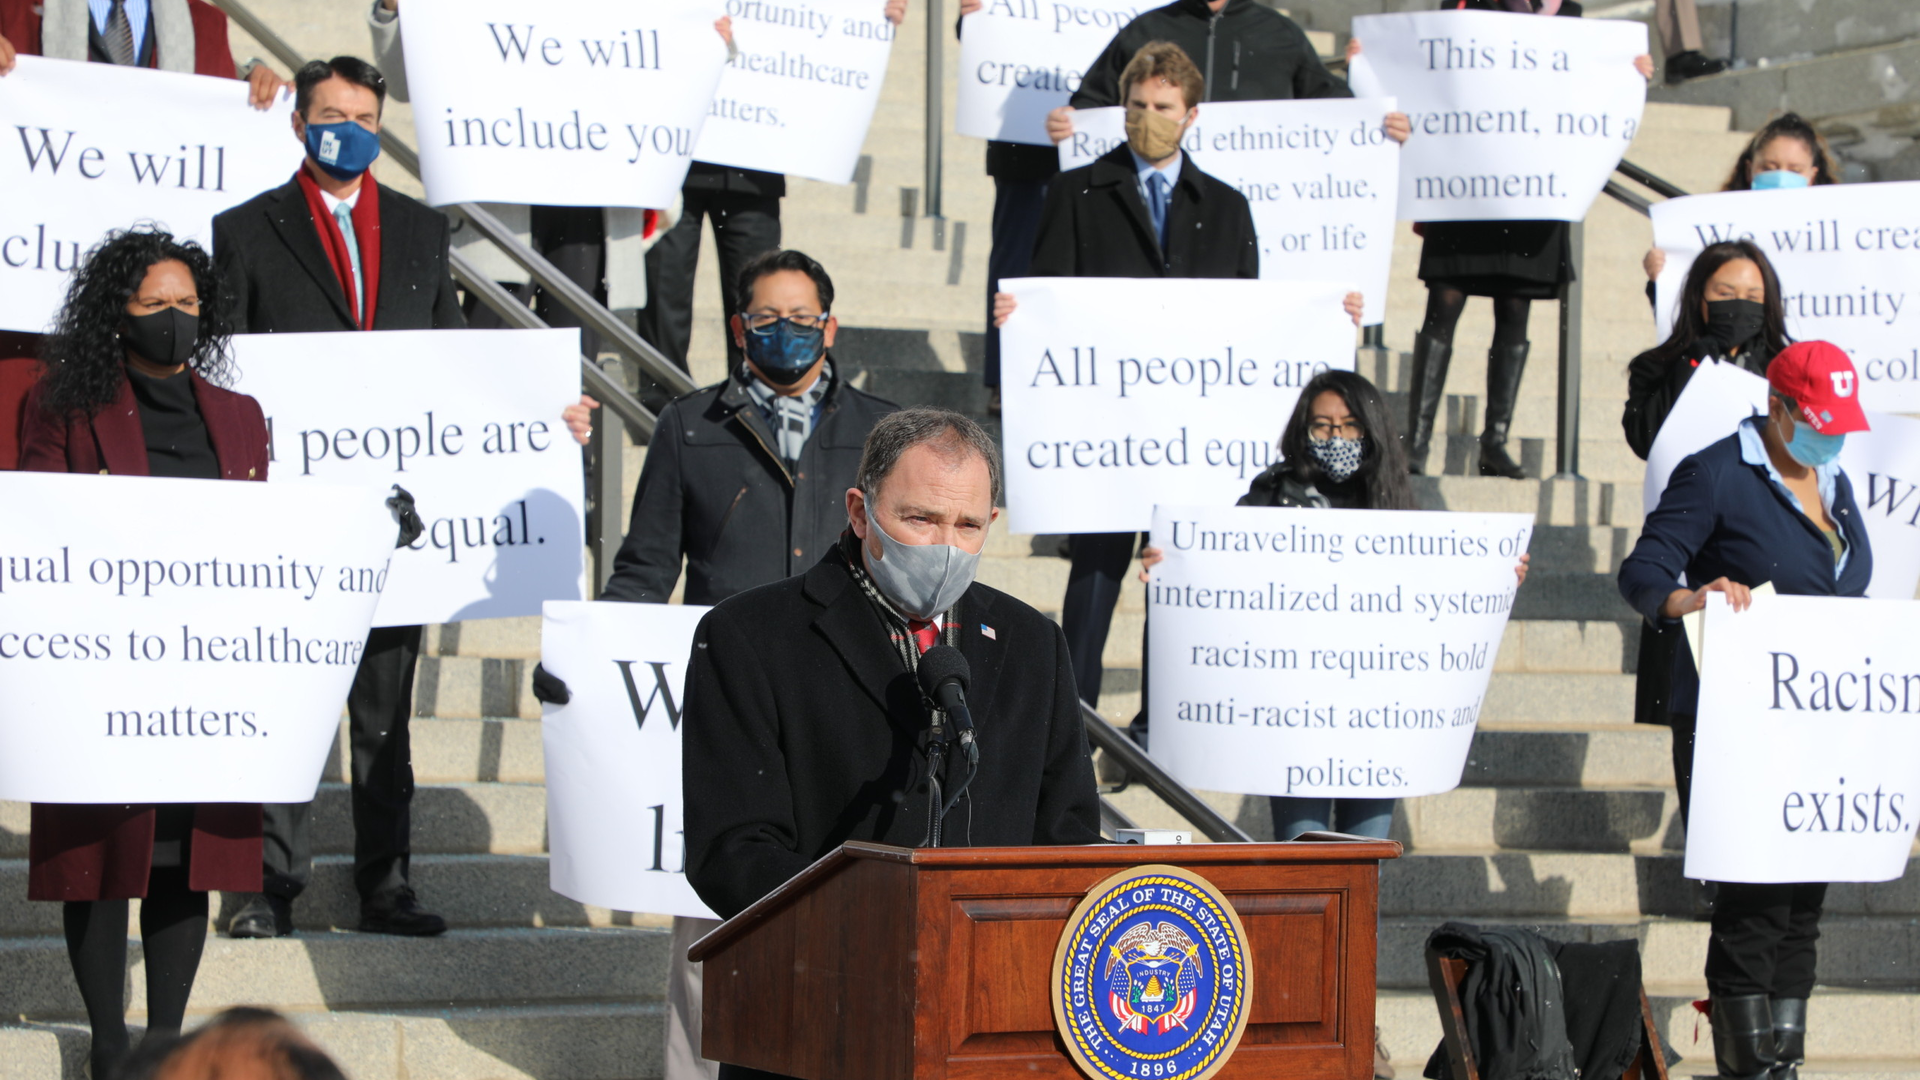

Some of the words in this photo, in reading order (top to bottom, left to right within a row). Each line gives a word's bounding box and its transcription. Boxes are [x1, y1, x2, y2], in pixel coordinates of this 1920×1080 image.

[726, 0, 833, 38] ortunity
[488, 23, 563, 66] We
[579, 29, 662, 70] will
[1419, 38, 1496, 72] This
[1510, 40, 1538, 71] is
[1551, 50, 1570, 71] a
[977, 60, 1083, 93] create
[445, 107, 609, 152] include
[1212, 123, 1339, 155] ethnicity
[1350, 120, 1386, 147] do
[1406, 107, 1541, 138] vement,
[1556, 108, 1612, 138] not
[1621, 117, 1637, 141] a
[14, 126, 105, 179] We
[128, 144, 227, 193] will
[1291, 173, 1378, 201] value,
[1415, 171, 1568, 199] moment.
[1281, 233, 1312, 252] or
[1322, 224, 1367, 251] life
[1771, 220, 1841, 251] will
[1029, 346, 1099, 387] All
[1117, 347, 1258, 397] people
[1830, 370, 1854, 398] U
[298, 411, 464, 476] people
[483, 418, 551, 454] are
[1027, 427, 1189, 468] created
[1171, 521, 1344, 562] Unraveling
[1355, 531, 1489, 556] centuries
[1498, 530, 1524, 557] of
[89, 554, 325, 599] opportunity
[338, 557, 391, 594] and
[1153, 579, 1338, 612] internalized
[1350, 587, 1403, 614] and
[128, 630, 166, 662] to
[182, 625, 363, 666] healthcare
[1191, 642, 1298, 669] racism
[1310, 646, 1429, 678] requires
[1440, 642, 1488, 671] bold
[105, 705, 270, 738] matters.
[1177, 698, 1338, 729] anti-racist
[1348, 701, 1446, 730] actions
[1451, 696, 1480, 727] and
[1286, 758, 1409, 794] policies.
[1783, 777, 1909, 833] exists.
[1132, 888, 1155, 904] OF
[1161, 888, 1196, 912] THE
[1090, 898, 1130, 937] SEAL
[1196, 906, 1231, 960] STATE
[1073, 938, 1093, 1007] GREAT
[1136, 969, 1171, 978] INDUSTRY
[1222, 964, 1234, 990] OF
[1141, 1004, 1166, 1013] 1847
[1202, 993, 1231, 1047] UTAH
[1077, 1010, 1103, 1051] THE
[1129, 1061, 1178, 1077] 1896
